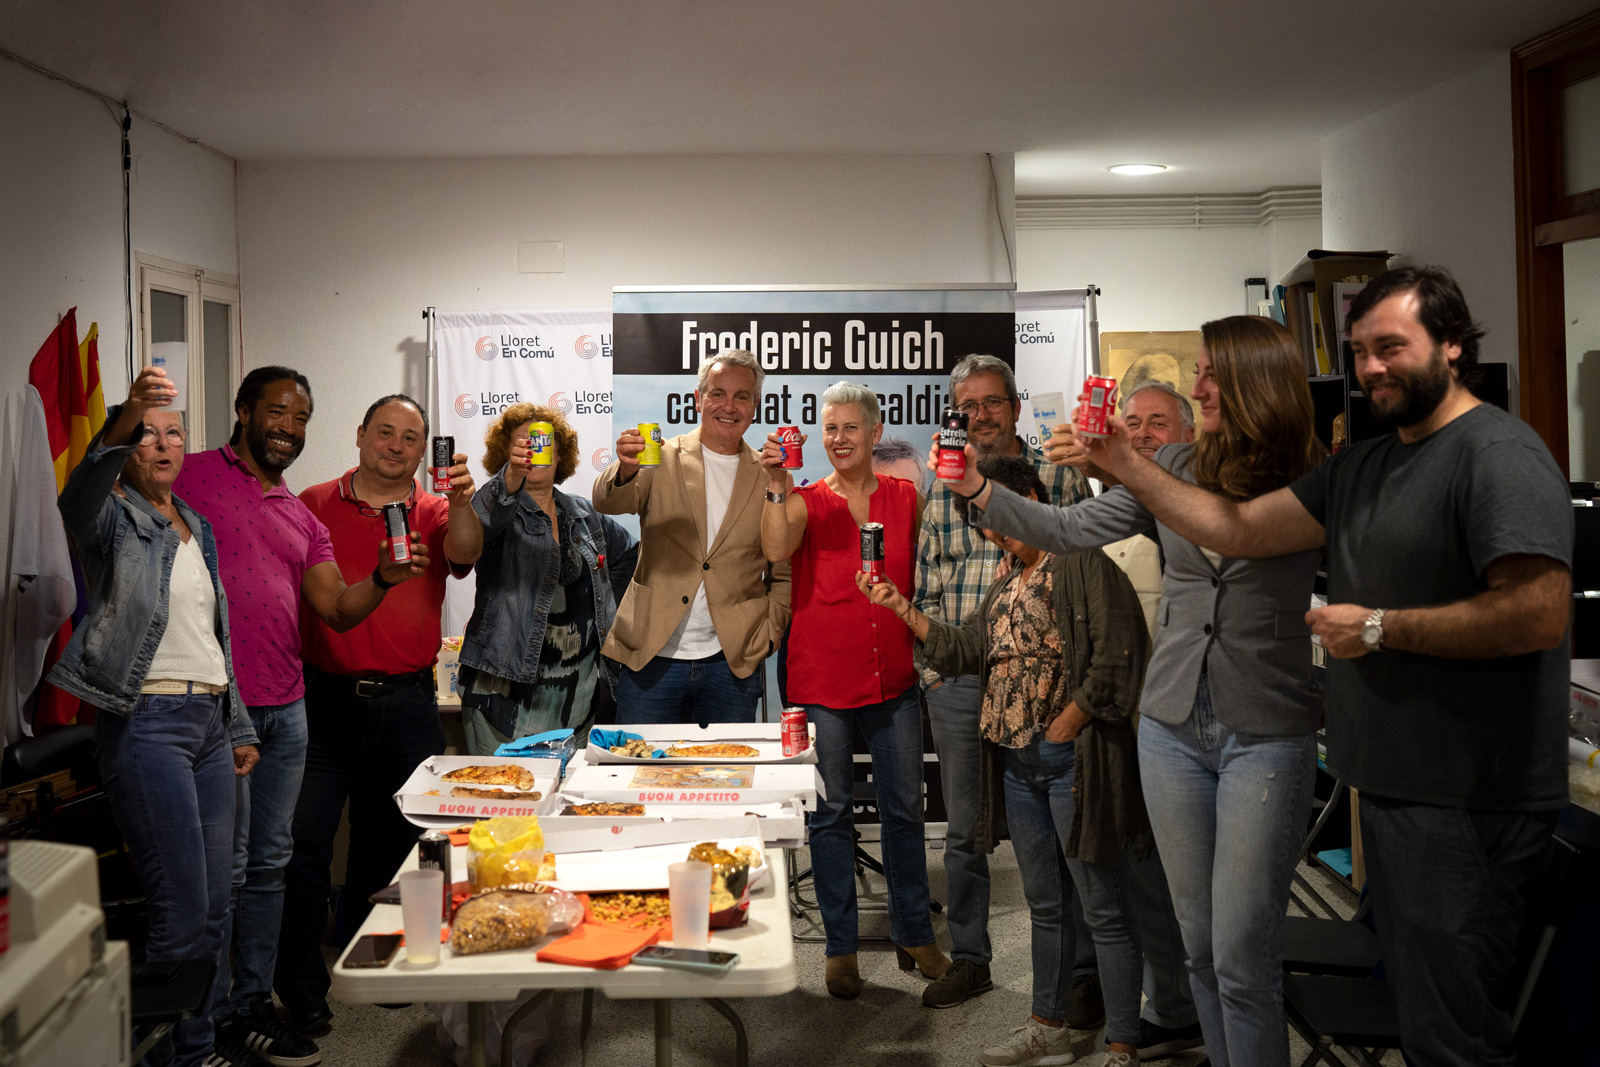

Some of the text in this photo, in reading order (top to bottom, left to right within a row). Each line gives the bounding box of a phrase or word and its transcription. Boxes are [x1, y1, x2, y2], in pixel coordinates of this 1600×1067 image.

[1014, 321, 1041, 333] oret
[501, 334, 540, 347] Lloret
[1019, 332, 1055, 344] Comú
[682, 320, 944, 370] Frederic Guich
[502, 347, 555, 359] En Comú
[481, 392, 520, 404] Lloret
[575, 391, 613, 403] Lloret
[482, 405, 497, 416] En
[576, 404, 591, 415] En
[667, 385, 792, 425] caat
[802, 393, 816, 425] a
[940, 427, 967, 438] Estrella
[940, 436, 966, 447] Galicia
[638, 792, 740, 802] BUON APPETITO
[438, 803, 535, 817] BUON APPETIT
